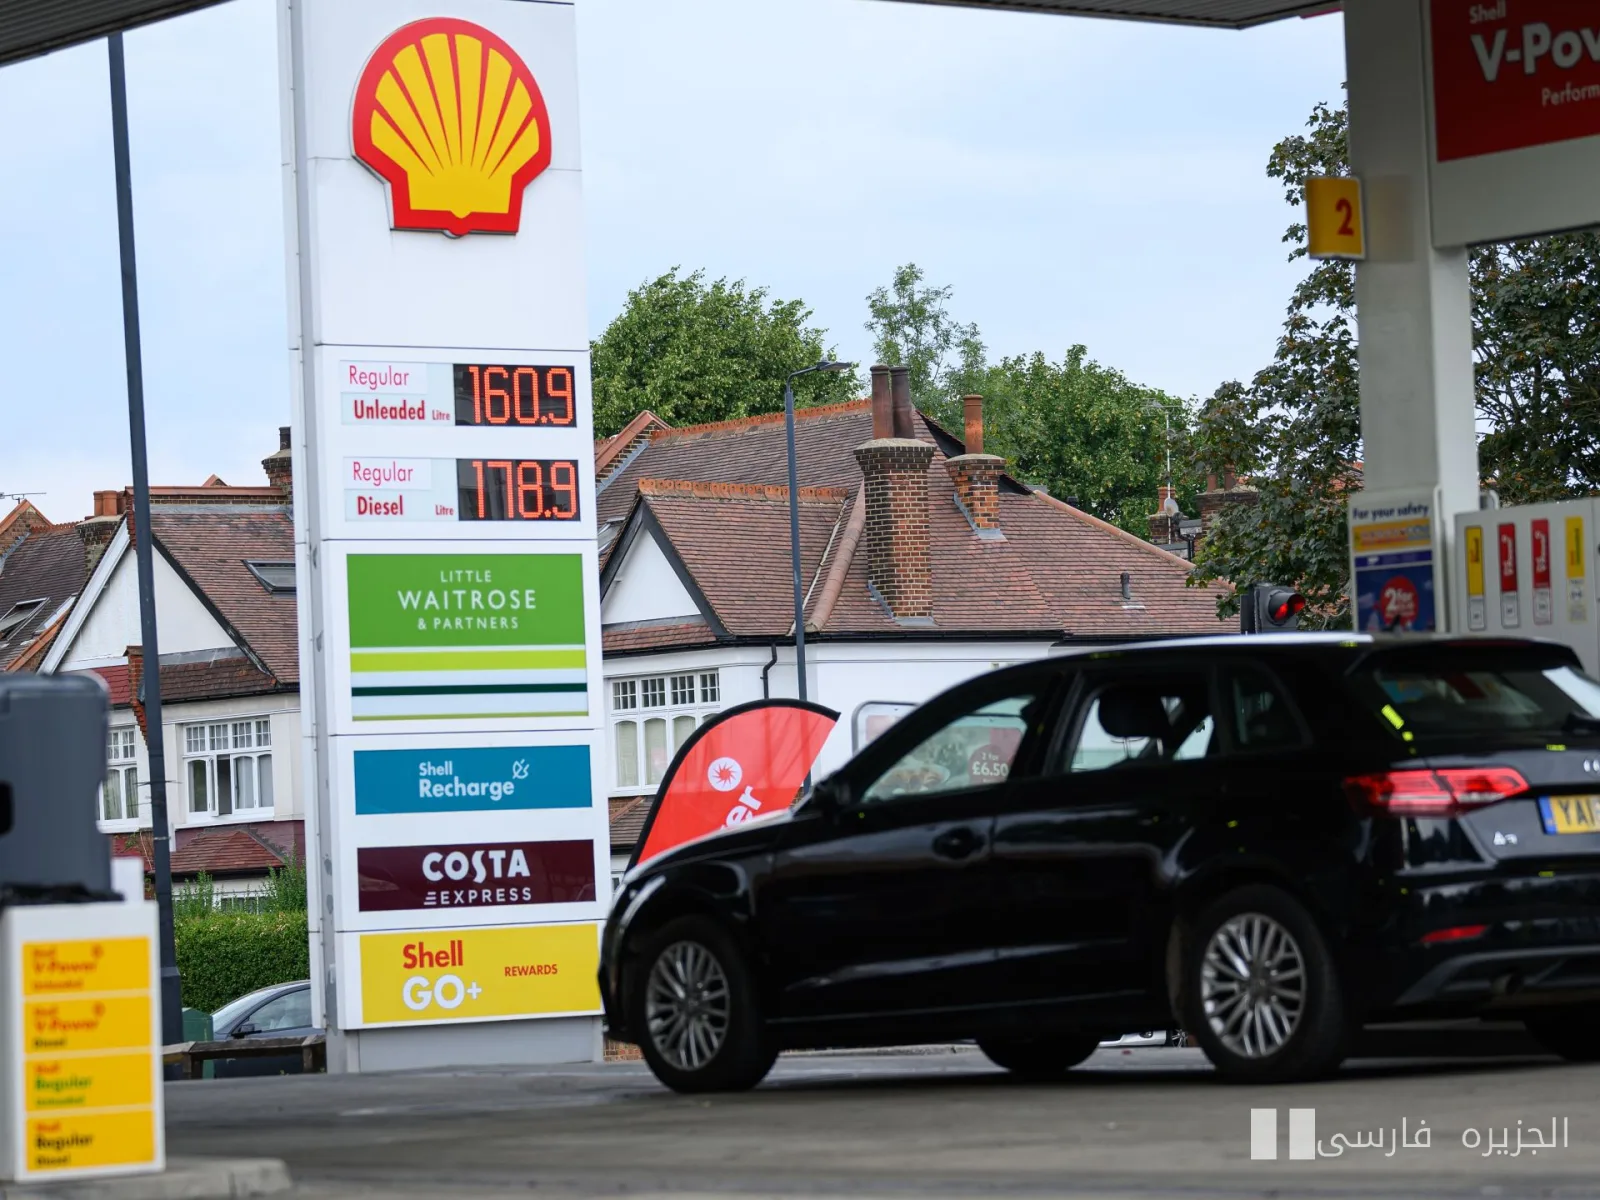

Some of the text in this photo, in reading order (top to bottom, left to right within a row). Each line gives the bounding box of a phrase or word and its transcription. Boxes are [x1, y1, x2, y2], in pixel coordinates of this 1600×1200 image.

[1469, 0, 1506, 24] Shell
[1335, 197, 1355, 236] 2
[349, 365, 410, 390] Regular
[469, 366, 573, 424] 160.9
[354, 399, 450, 421] Unleaded Litre
[353, 461, 413, 486] Regular
[472, 460, 577, 519] 178.9
[357, 495, 454, 516] Diesel Litre
[440, 569, 492, 583] LITTLE
[397, 589, 536, 610] WAITROSE
[417, 616, 519, 630] & PARTNERS
[419, 761, 453, 777] Shell
[972, 760, 1009, 777] £6.50
[419, 775, 515, 801] Recharge
[422, 848, 531, 884] COSTA
[440, 886, 532, 905] EXPRESS
[402, 939, 463, 969] Shell
[504, 963, 558, 977] REWARDS
[402, 974, 482, 1011] GO+
